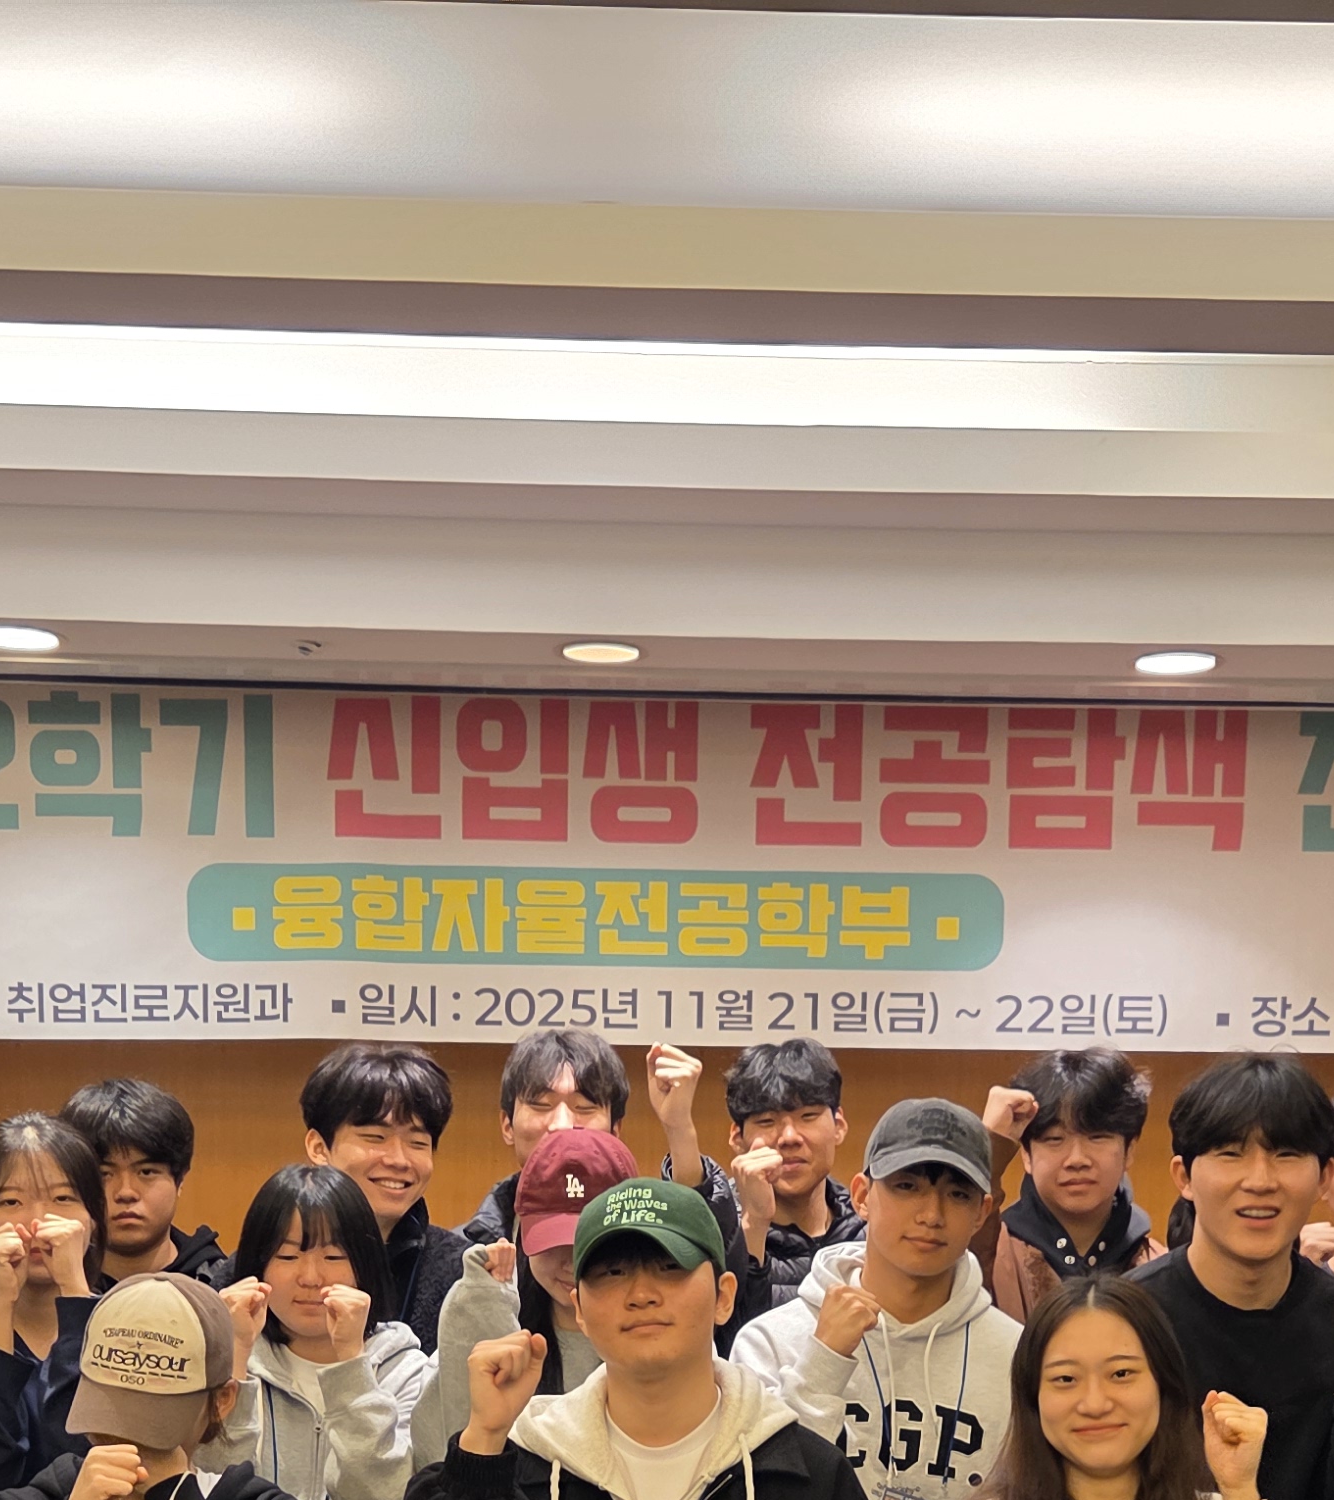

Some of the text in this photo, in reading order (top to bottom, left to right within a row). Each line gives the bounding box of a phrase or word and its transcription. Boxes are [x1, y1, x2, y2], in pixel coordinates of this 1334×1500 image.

[327, 695, 699, 846] 신입생
[748, 703, 1249, 852] 전공탐색
[273, 876, 910, 959] 융합자율전공학부
[8, 982, 293, 1023] 취업진로지원과
[473, 986, 638, 1029] 2025년
[658, 990, 752, 1031] 11월
[768, 991, 938, 1034] 21일(금)
[996, 994, 1167, 1036] 22일(토)
[566, 1174, 584, 1198] LA
[607, 1187, 652, 1205] Riding
[603, 1209, 663, 1226] of Life.
[606, 1199, 668, 1212] the Waves
